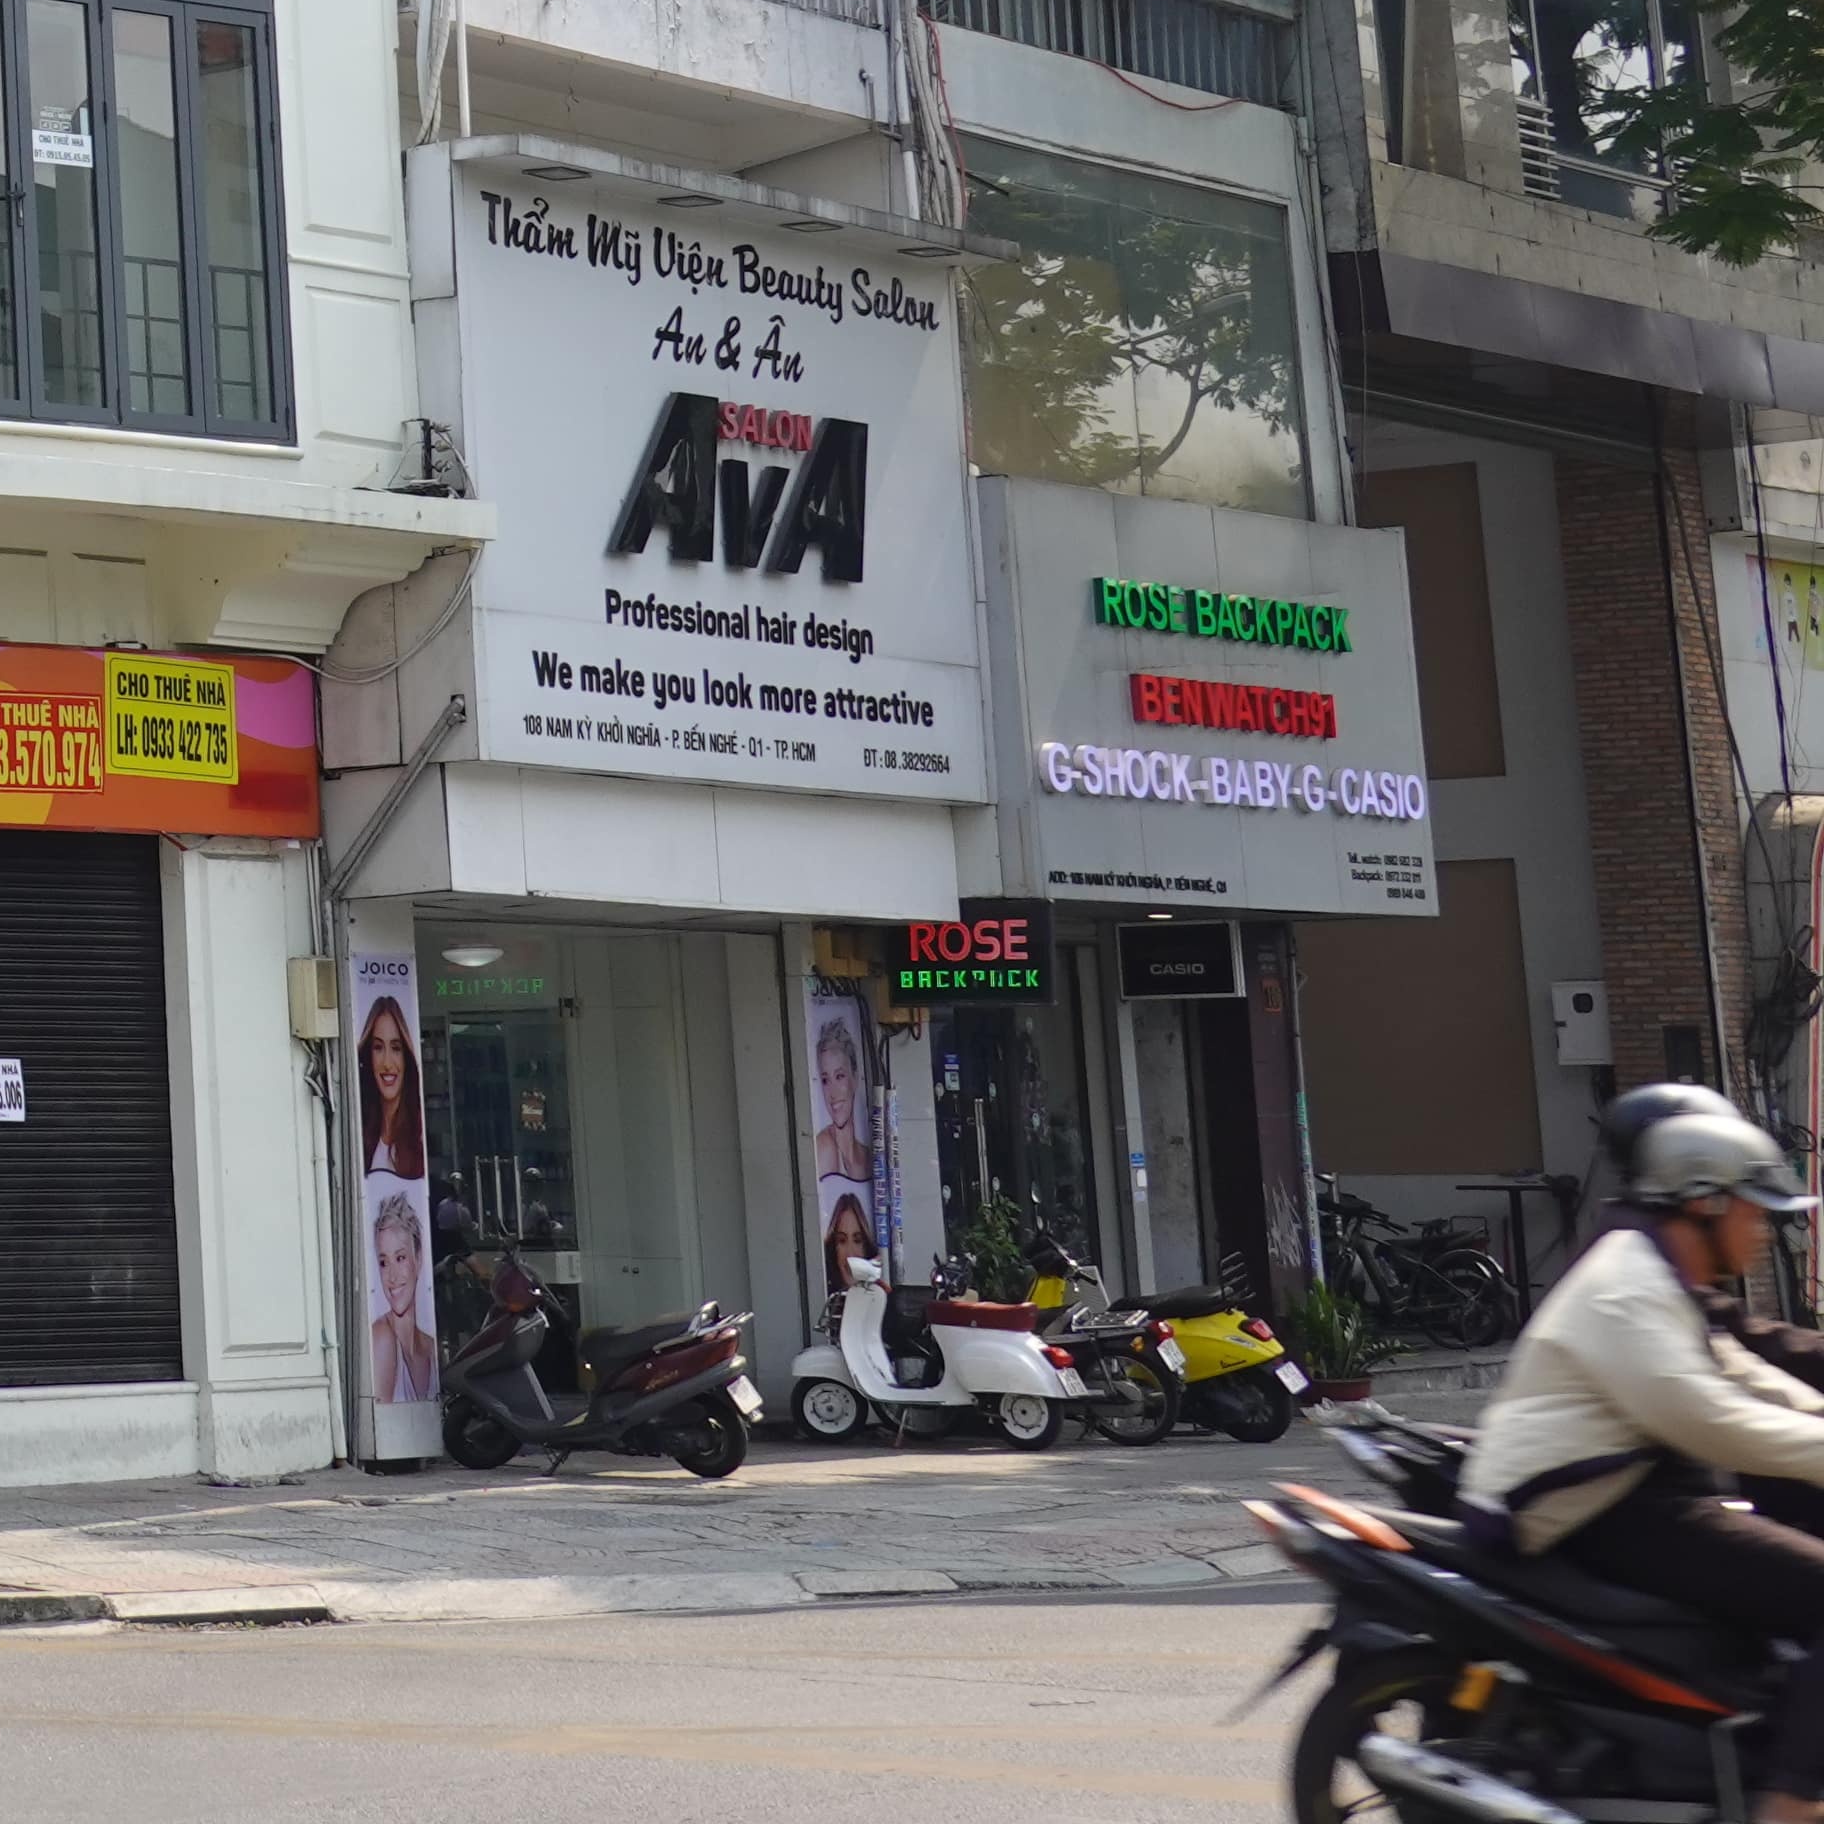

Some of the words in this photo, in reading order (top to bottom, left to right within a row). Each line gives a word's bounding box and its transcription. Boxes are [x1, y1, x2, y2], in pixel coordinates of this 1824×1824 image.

[480, 191, 578, 259] Thẩm
[588, 215, 642, 285] Mỹ
[653, 227, 728, 295] Viện
[733, 245, 843, 324] Beauty
[852, 269, 940, 331] Salon
[653, 307, 707, 362] An
[715, 316, 741, 372] &
[752, 316, 804, 383] Ân
[718, 401, 812, 452] SALON
[605, 589, 749, 640] Professional
[756, 606, 795, 646] hair
[803, 613, 874, 664] design
[1094, 577, 1189, 634] ROSE
[1191, 589, 1353, 652] BACKPACK
[0, 698, 52, 728] THUÊ
[58, 699, 99, 728] NHÀ
[532, 650, 572, 689] We
[580, 658, 645, 698] make
[653, 672, 695, 710] you
[703, 669, 753, 709] look
[760, 688, 816, 715] more
[824, 690, 934, 727] attractive
[523, 715, 542, 736] 108
[547, 717, 572, 738] NAM
[577, 716, 591, 741] KỲ
[597, 715, 623, 744] KHỞI
[627, 723, 660, 747] NGHĨA
[684, 724, 706, 751] BẾN
[709, 731, 738, 754] NGHÉ
[749, 737, 763, 758] Q1
[774, 740, 789, 760] TP.
[792, 742, 815, 762] HCM
[910, 919, 1029, 962] ROSE
[360, 962, 408, 976] JOICO
[1150, 963, 1204, 975] CASIO
